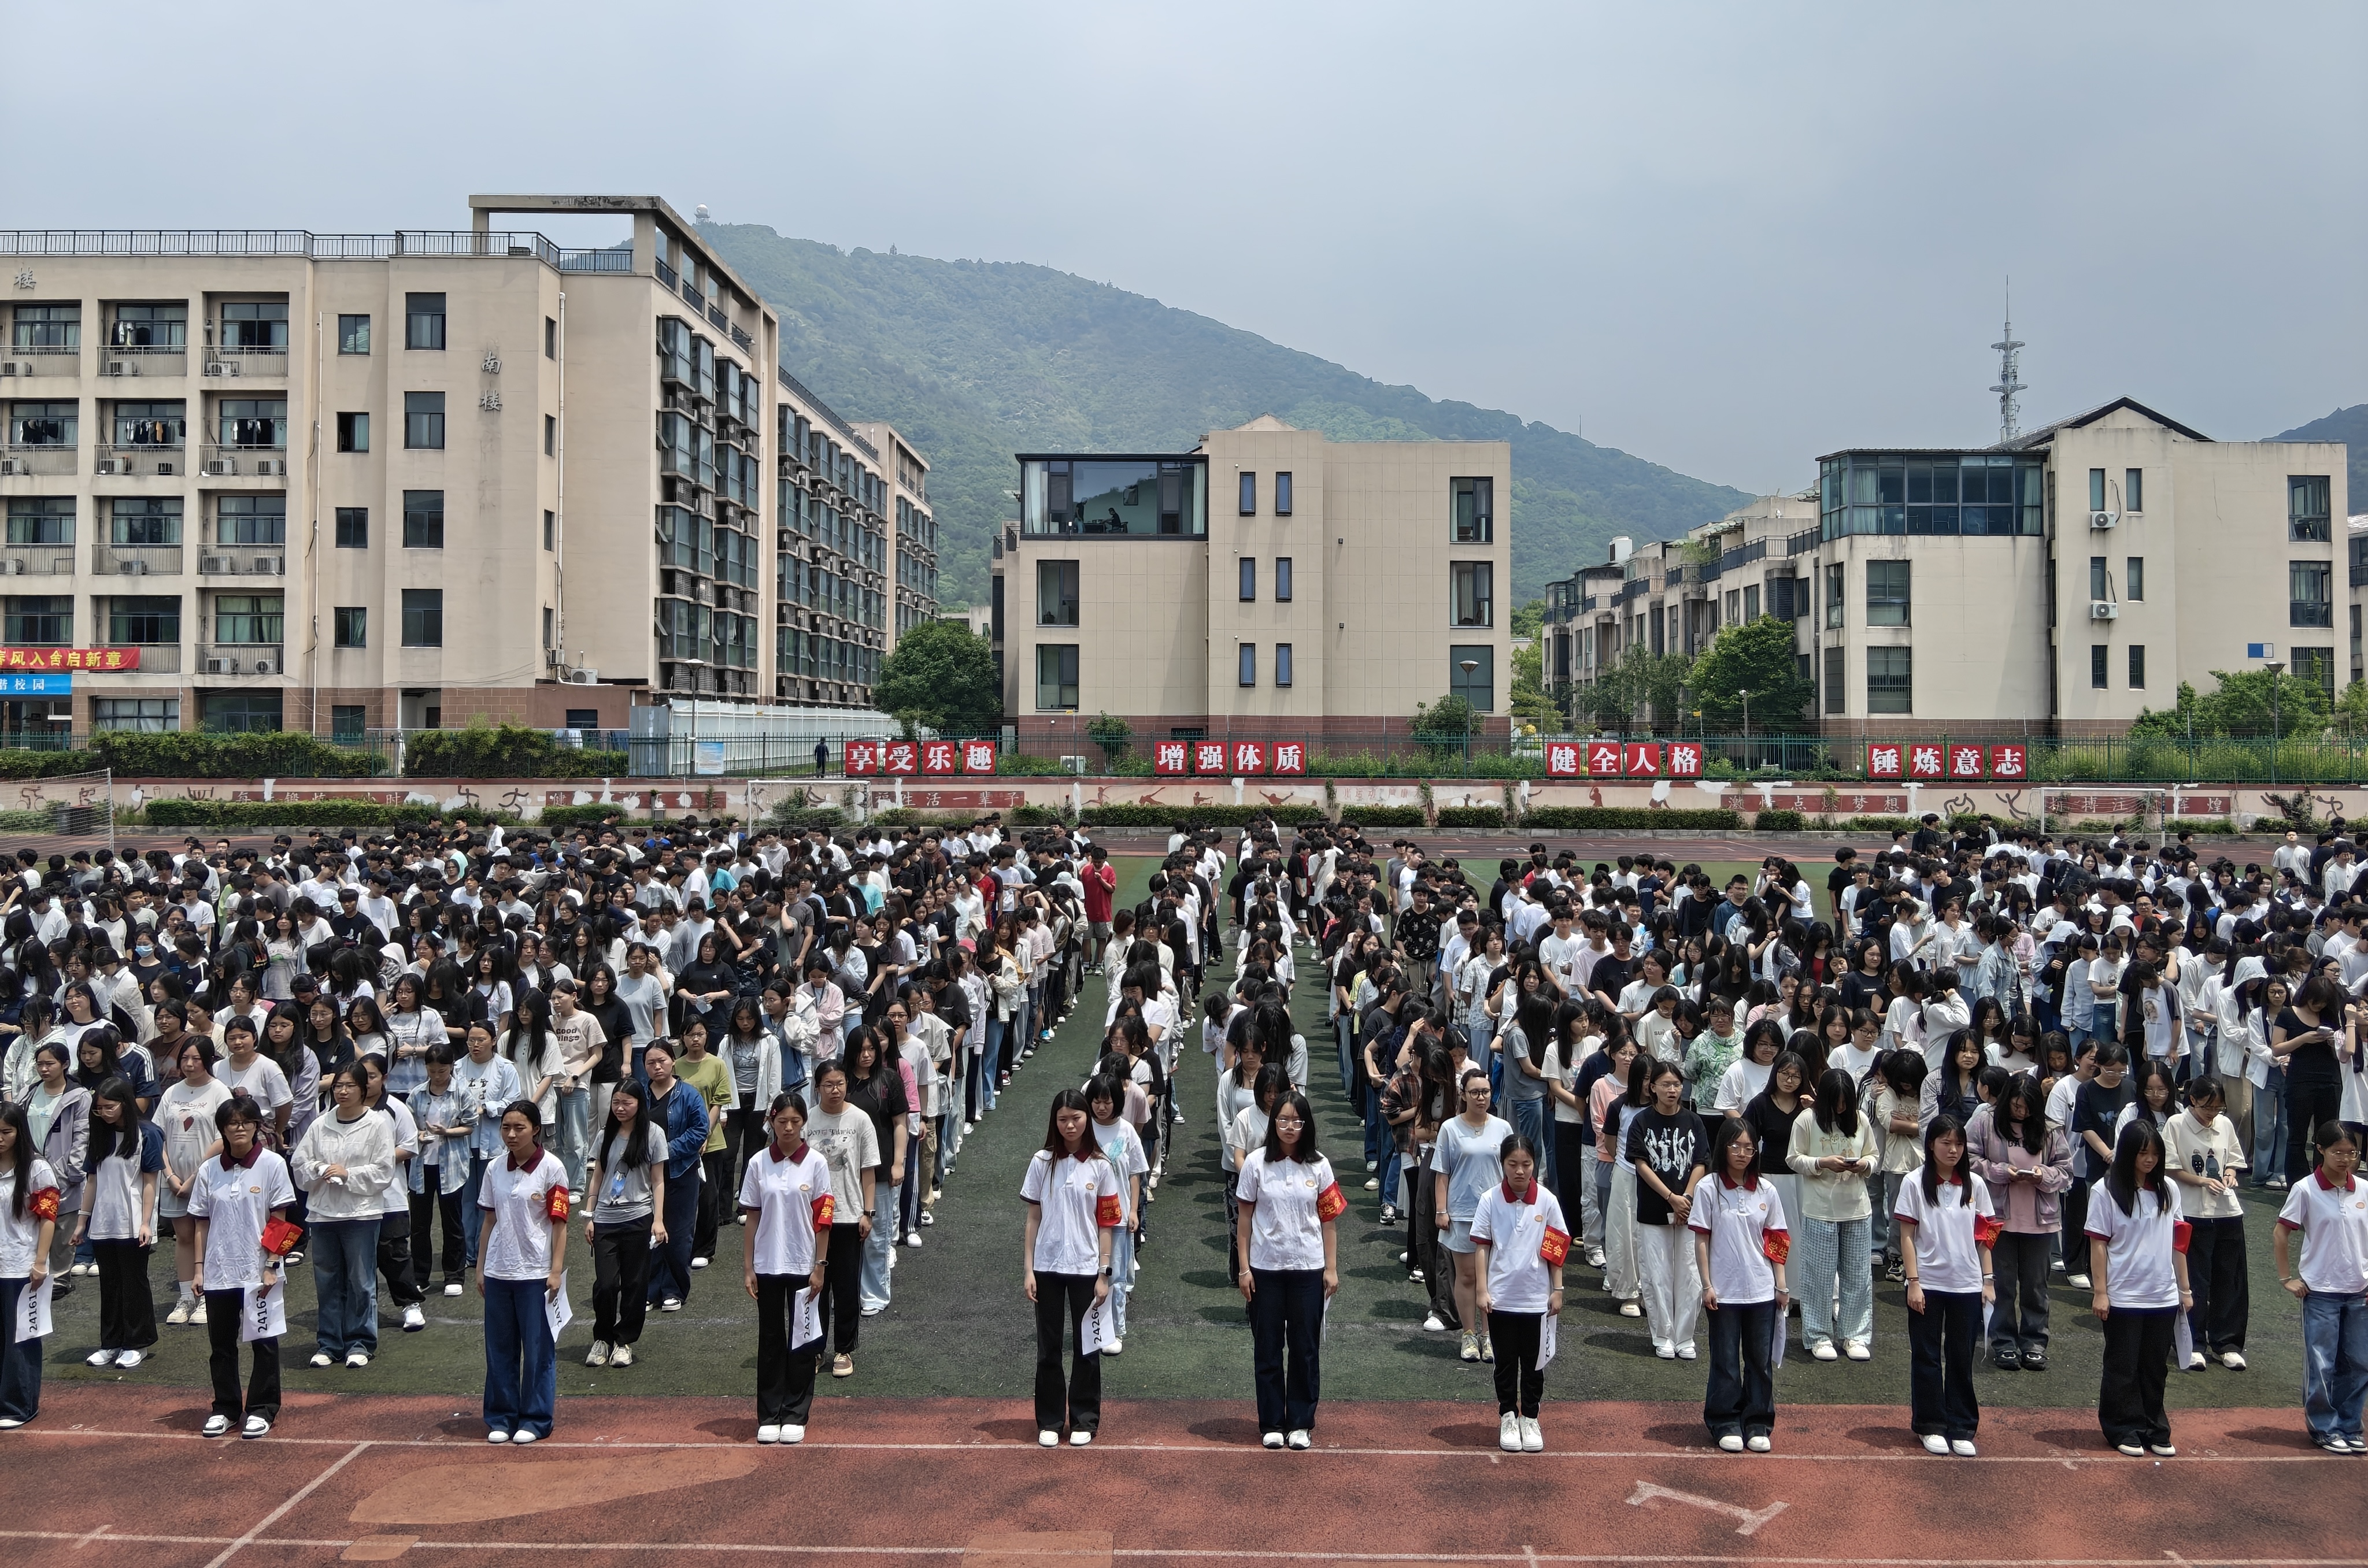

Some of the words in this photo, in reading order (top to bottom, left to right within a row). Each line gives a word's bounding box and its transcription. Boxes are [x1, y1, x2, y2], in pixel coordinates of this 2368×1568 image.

[479, 351, 503, 412] 南楼
[849, 744, 991, 771] 享受乐趣
[1158, 744, 1301, 771] 增强体质
[1550, 746, 1697, 773] 健全人格
[1871, 748, 2022, 775] 锤炼意志
[1542, 1240, 1563, 1258] 生会
